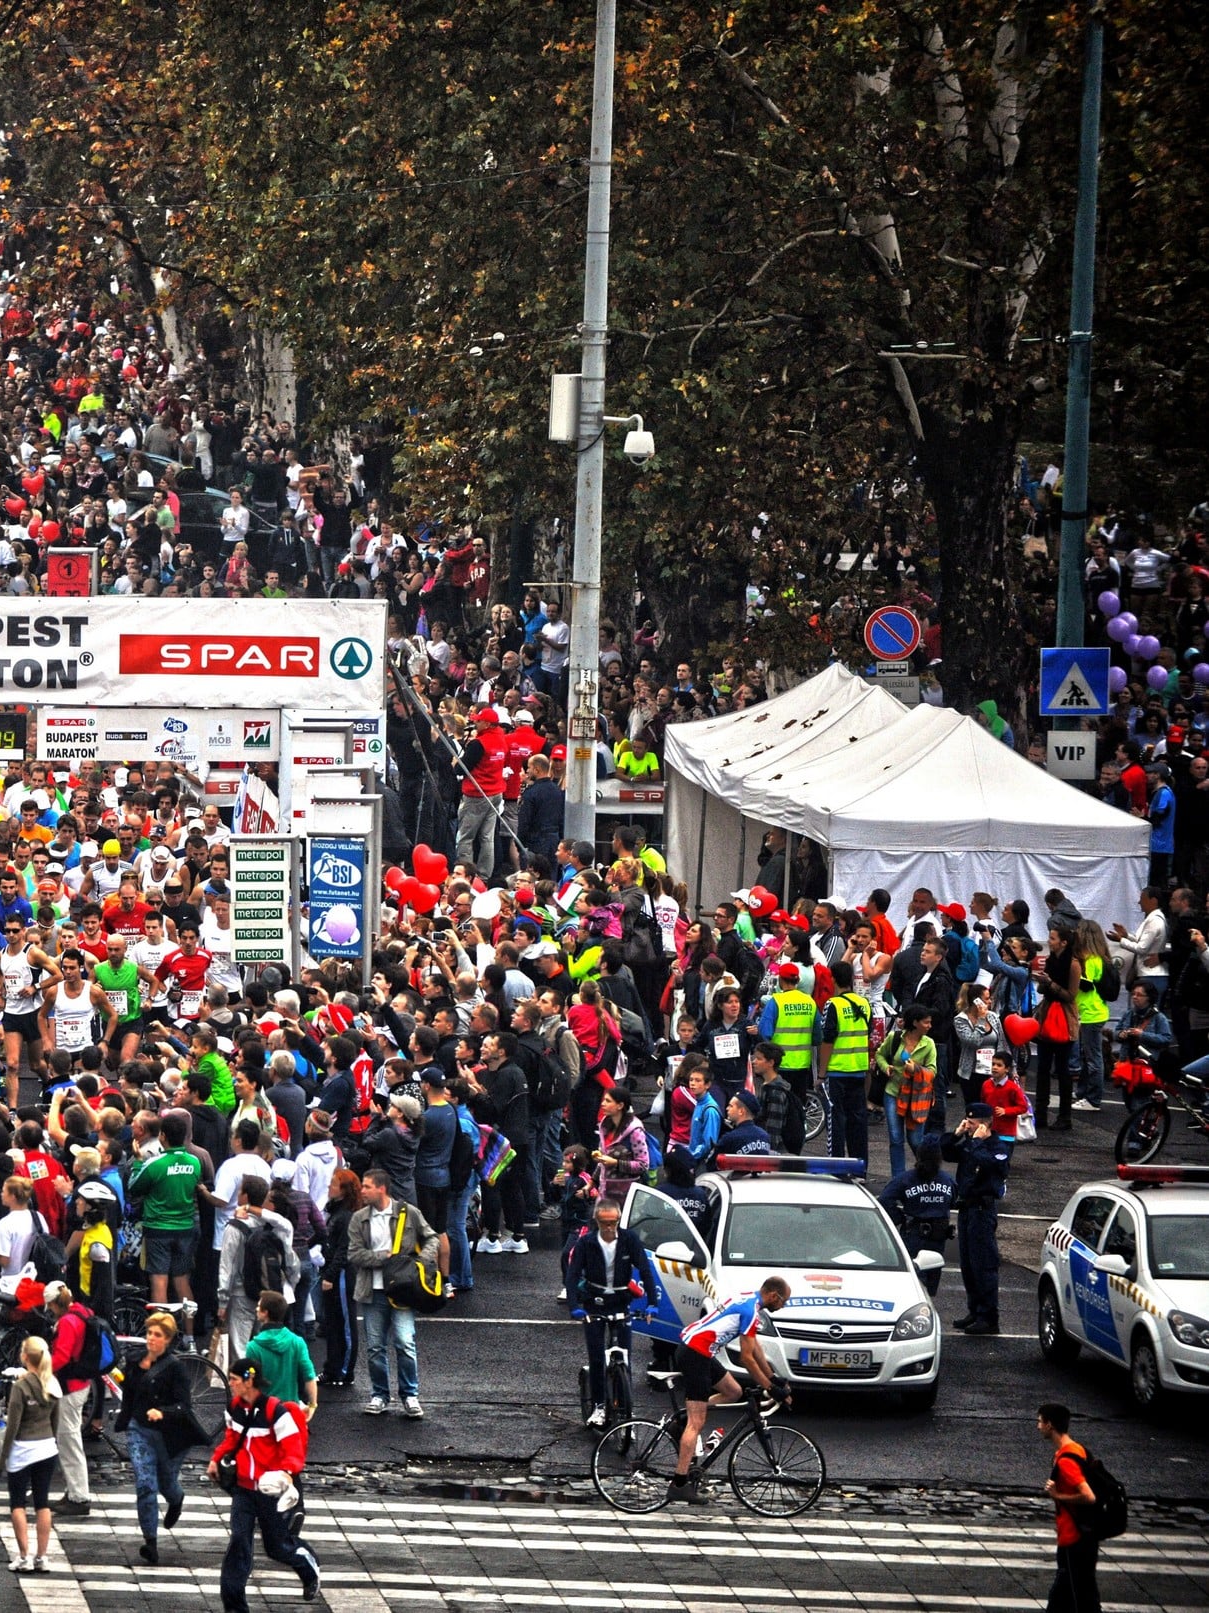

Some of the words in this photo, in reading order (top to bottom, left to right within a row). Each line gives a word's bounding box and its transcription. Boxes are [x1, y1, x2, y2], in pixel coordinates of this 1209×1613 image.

[63, 562, 72, 576] 1
[160, 643, 315, 671] SPAR
[172, 722, 184, 733] BSI
[46, 732, 98, 743] BUDAPEST
[208, 736, 232, 744] MOB
[1053, 746, 1085, 761] VIP
[218, 783, 241, 793] SP
[633, 792, 662, 801] SP
[337, 843, 363, 851] VELÜNK!
[238, 850, 282, 861] metropol
[237, 871, 282, 882] metropol
[331, 865, 352, 884] BSI
[237, 890, 282, 901] metropol
[236, 909, 280, 919] metropol
[237, 928, 281, 939] metropol
[237, 949, 282, 960] metropol
[736, 1140, 772, 1155] RENDŐRS
[167, 1162, 195, 1176] MÉXICO
[904, 1181, 952, 1199] RENDŐRSÉ
[810, 1351, 869, 1365] MFR-692
